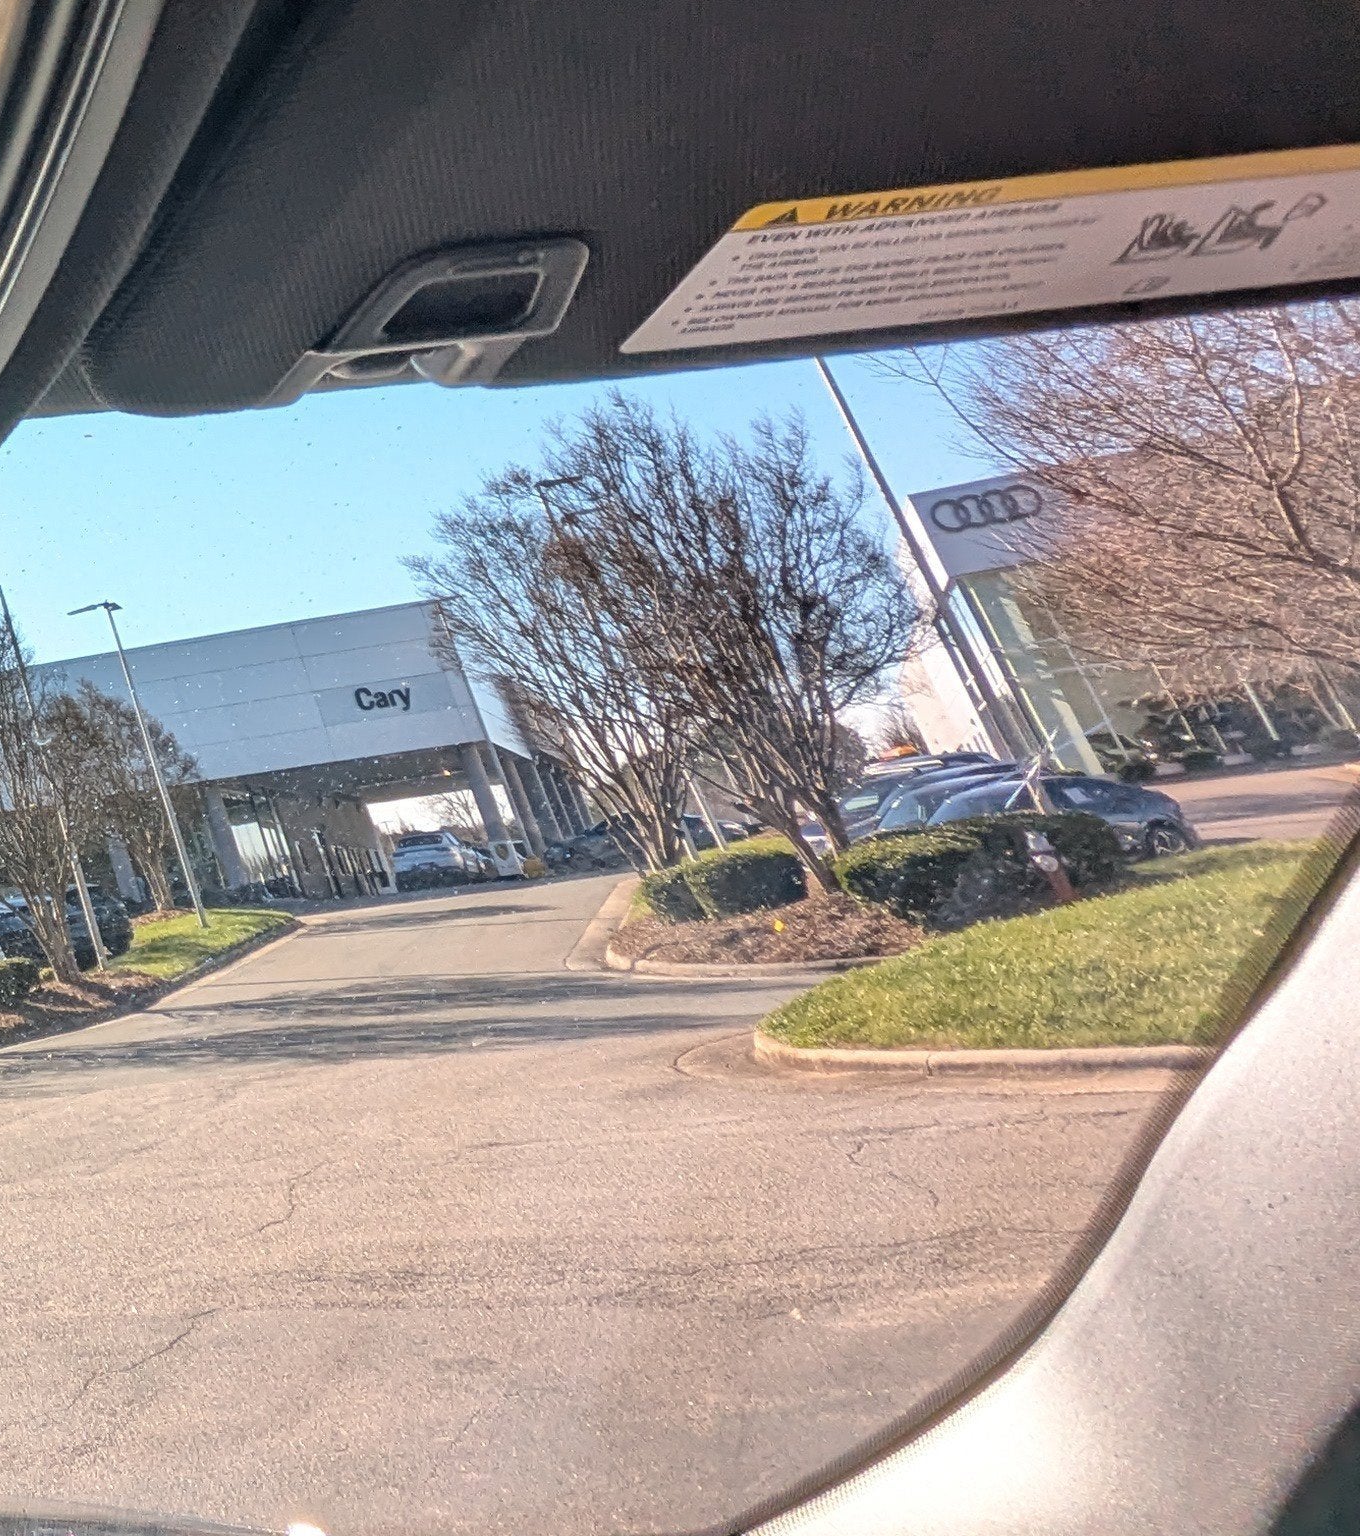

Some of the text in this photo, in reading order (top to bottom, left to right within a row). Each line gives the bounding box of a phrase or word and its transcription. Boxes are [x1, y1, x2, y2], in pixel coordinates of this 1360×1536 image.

[826, 186, 1002, 221] WARNING
[748, 230, 802, 244] EVEN
[805, 225, 858, 238] WITH
[354, 686, 412, 712] Cary
